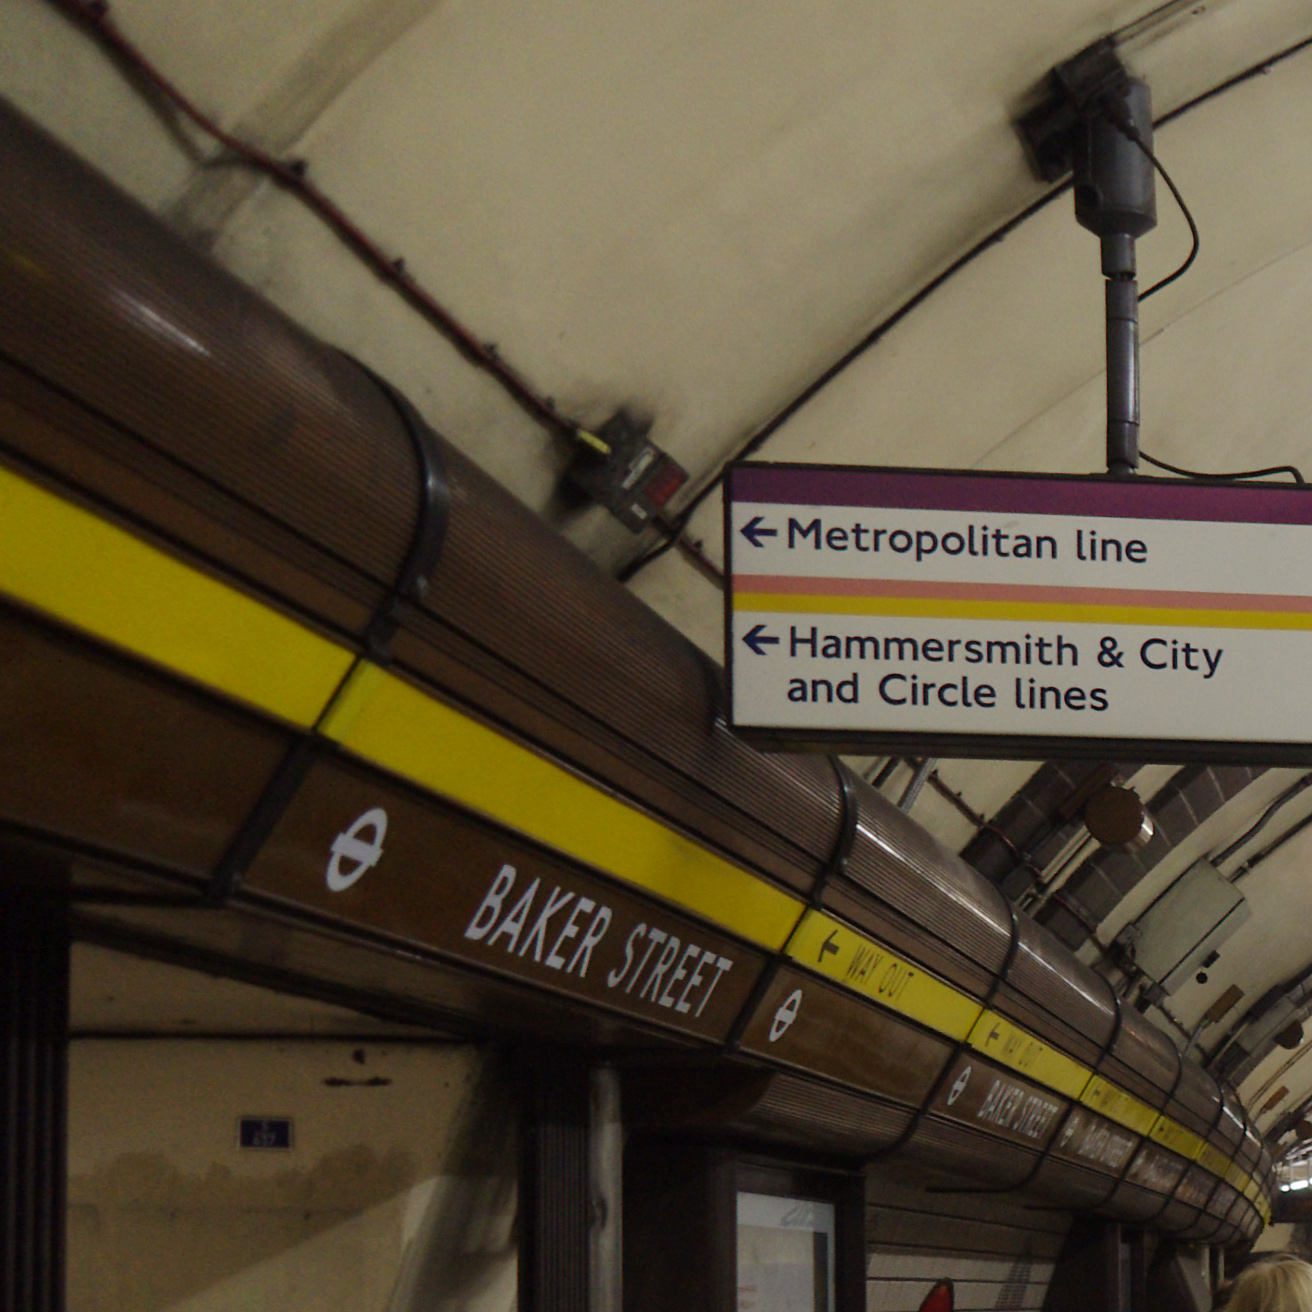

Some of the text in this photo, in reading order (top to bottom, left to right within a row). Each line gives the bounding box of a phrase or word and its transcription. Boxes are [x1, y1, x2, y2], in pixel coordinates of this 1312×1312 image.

[787, 517, 1149, 563] Metropolitan line
[788, 625, 1223, 680] Hammersmith & City
[787, 671, 1110, 712] and Circle lines
[464, 863, 733, 1018] BAKER STREET
[846, 943, 915, 1001] WAY OUT
[977, 1079, 1025, 1127] BAKER
[1012, 1095, 1059, 1139] STREET
